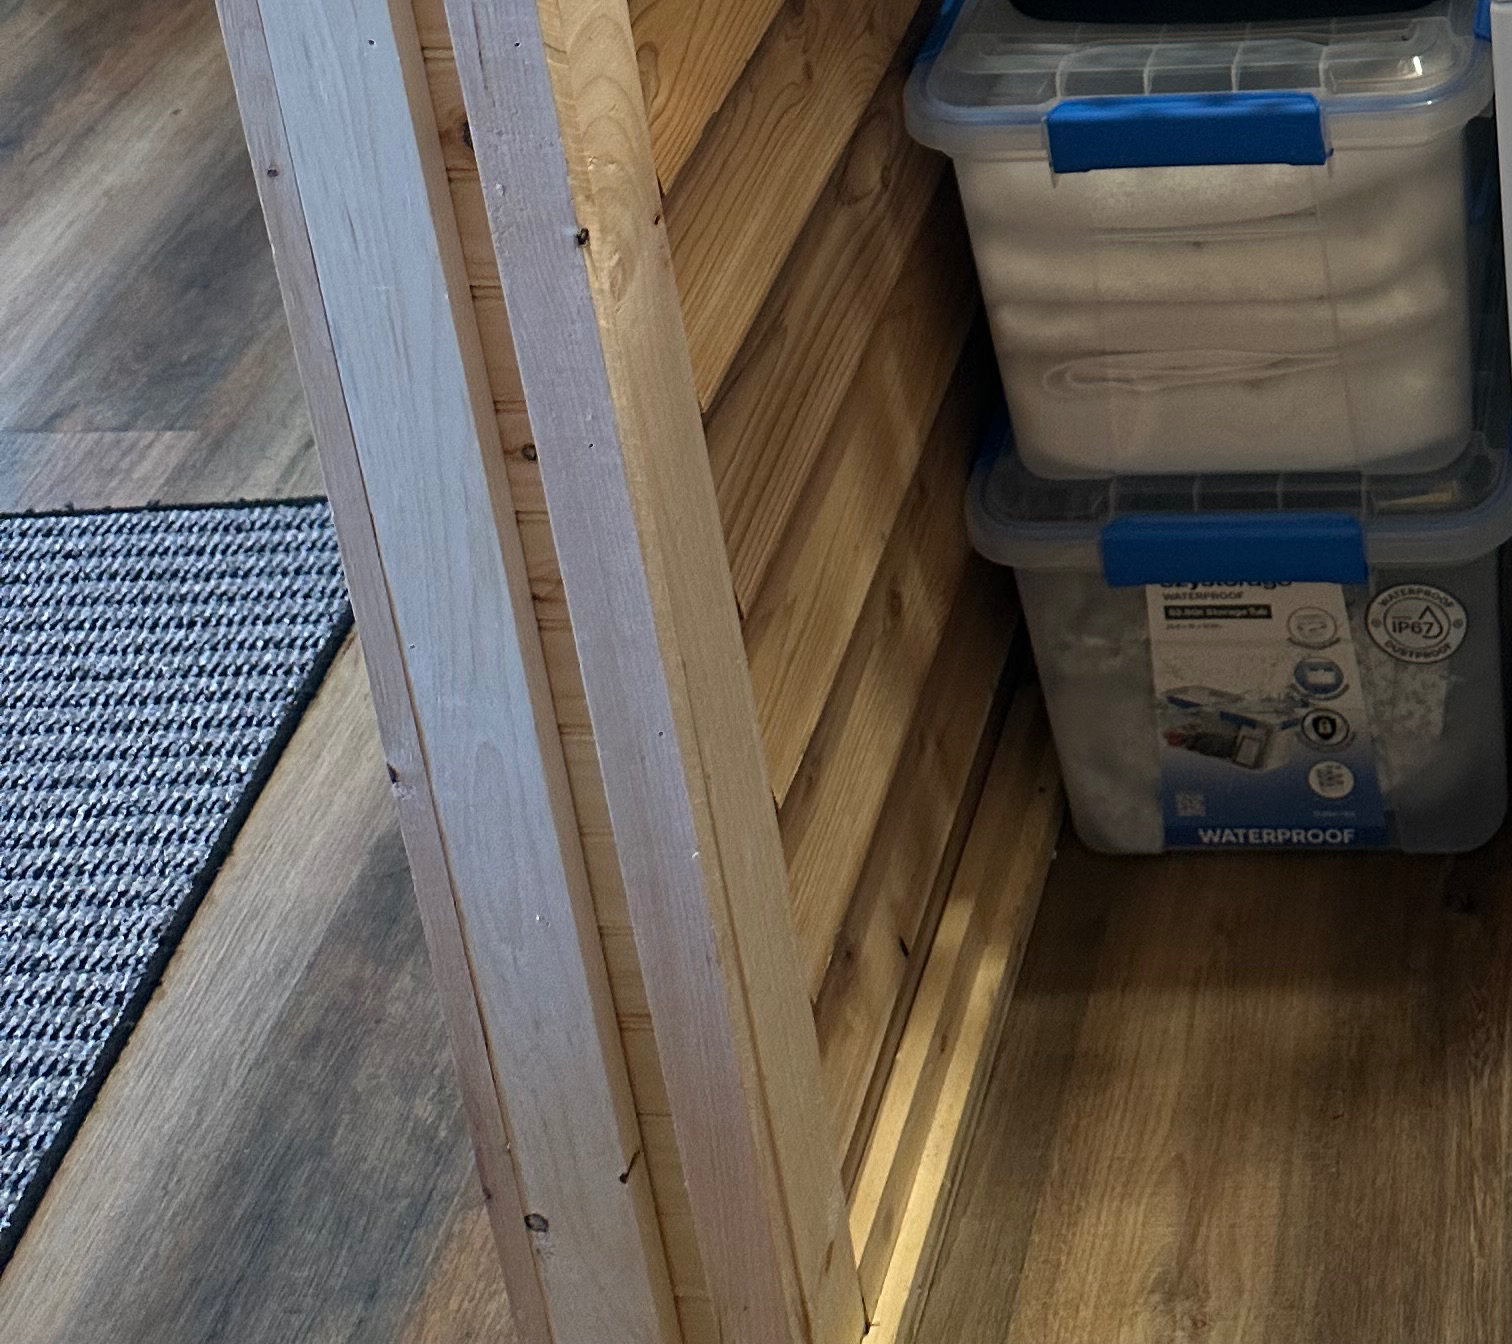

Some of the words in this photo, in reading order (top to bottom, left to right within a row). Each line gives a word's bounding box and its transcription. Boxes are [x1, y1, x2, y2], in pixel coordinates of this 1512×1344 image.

[1162, 591, 1244, 601] WATERPROOF
[1379, 587, 1454, 607] WATERPROOF
[1392, 620, 1435, 635] IP67
[1385, 640, 1451, 659] DUSTPROOF
[1198, 828, 1356, 844] WATERPROOF
